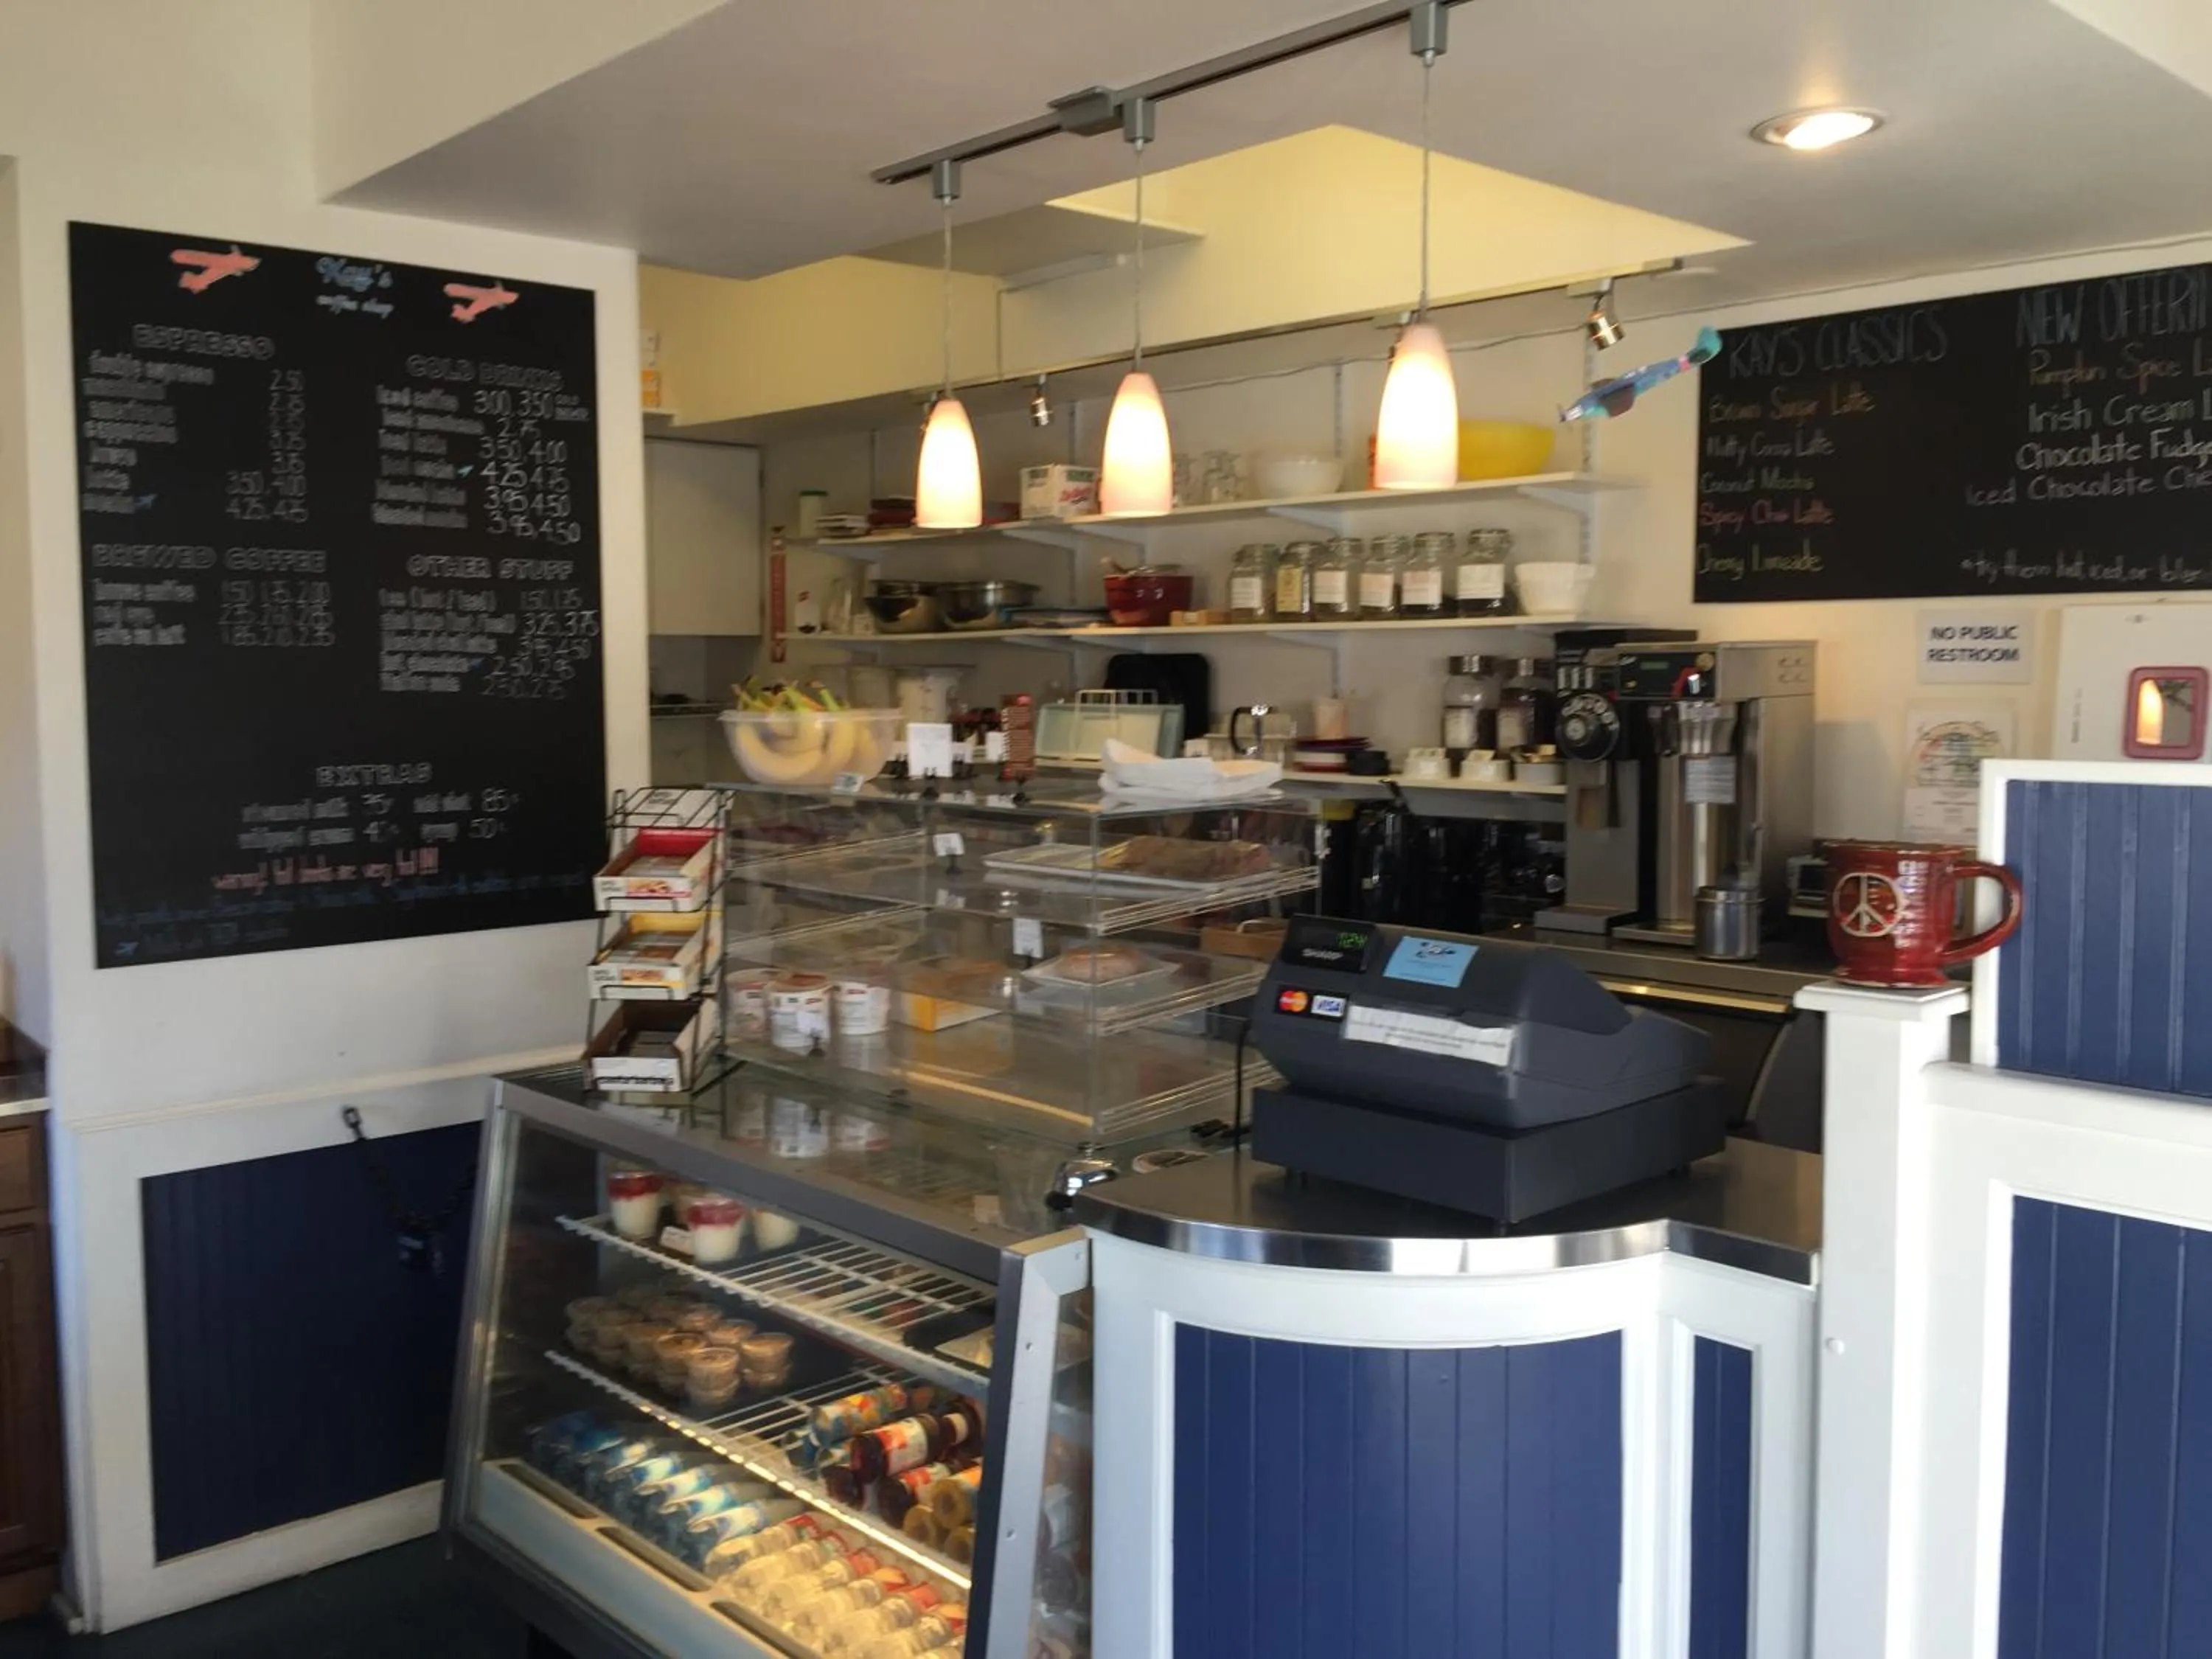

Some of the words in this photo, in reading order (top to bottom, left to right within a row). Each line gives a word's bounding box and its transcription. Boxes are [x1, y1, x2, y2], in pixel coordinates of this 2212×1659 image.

[2016, 284, 2085, 347] NEW
[2098, 267, 2212, 341] OFFERI
[1815, 307, 1947, 371] CLASSICS
[2028, 398, 2092, 433] Irish
[2104, 394, 2194, 427] Cream
[2016, 431, 2142, 470] Chocolate
[2028, 466, 2157, 501] Chocolate
[91, 543, 217, 569] BREWED
[224, 547, 327, 573] COFFEE
[406, 554, 492, 578] OTHER
[1931, 626, 1955, 640] NO
[1961, 625, 2019, 641] PUBLIC
[1927, 647, 2020, 663] RESTROOM
[316, 762, 433, 786] EXTRAS
